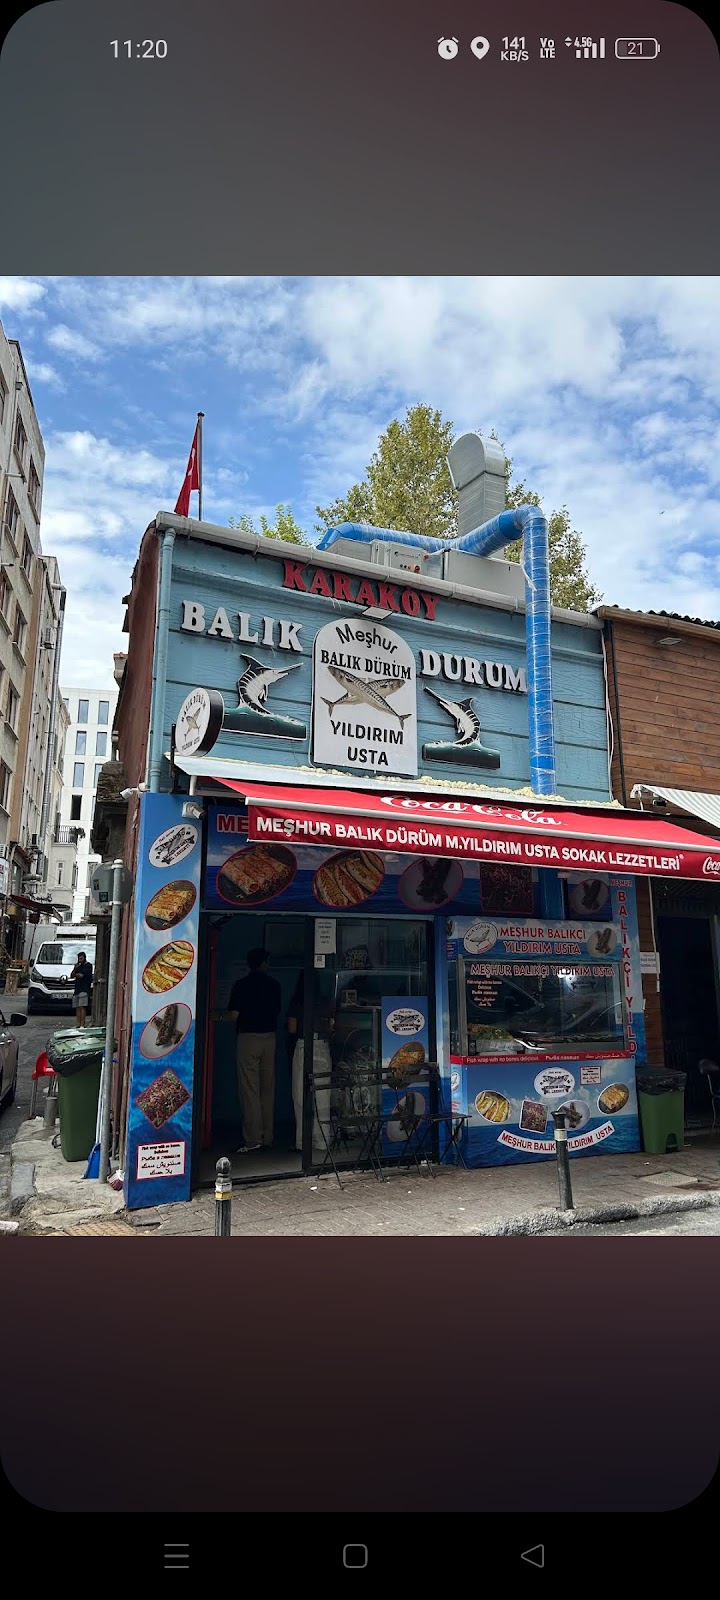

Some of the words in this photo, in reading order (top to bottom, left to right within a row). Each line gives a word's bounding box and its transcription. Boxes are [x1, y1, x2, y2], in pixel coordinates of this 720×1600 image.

[181, 600, 303, 652] BALIK
[335, 623, 398, 654] Meşhur
[320, 650, 362, 671] BALIK
[420, 649, 528, 693] DURUM
[330, 719, 404, 745] YILDIRIM
[347, 746, 389, 766] USTA
[256, 816, 331, 837] MEŞHUR
[335, 824, 384, 842] BALIK
[386, 826, 442, 849] DÜRÜM
[524, 843, 560, 859] USTA
[561, 847, 607, 864] SOKAK
[499, 926, 544, 940] MEŞHUR
[547, 929, 586, 943] BALIKÇI
[503, 941, 552, 954] YILDIRIM
[554, 942, 581, 955] USTA
[470, 963, 511, 978] MEŞHUR
[513, 964, 549, 979] BALIKÇI
[593, 966, 615, 977] USTA
[625, 996, 638, 1058] YILD
[501, 1133, 532, 1150] MEŞHUR
[533, 1143, 556, 1151] BALIK
[565, 1135, 594, 1150] ILDIRIM
[595, 1125, 613, 1140] USTA
